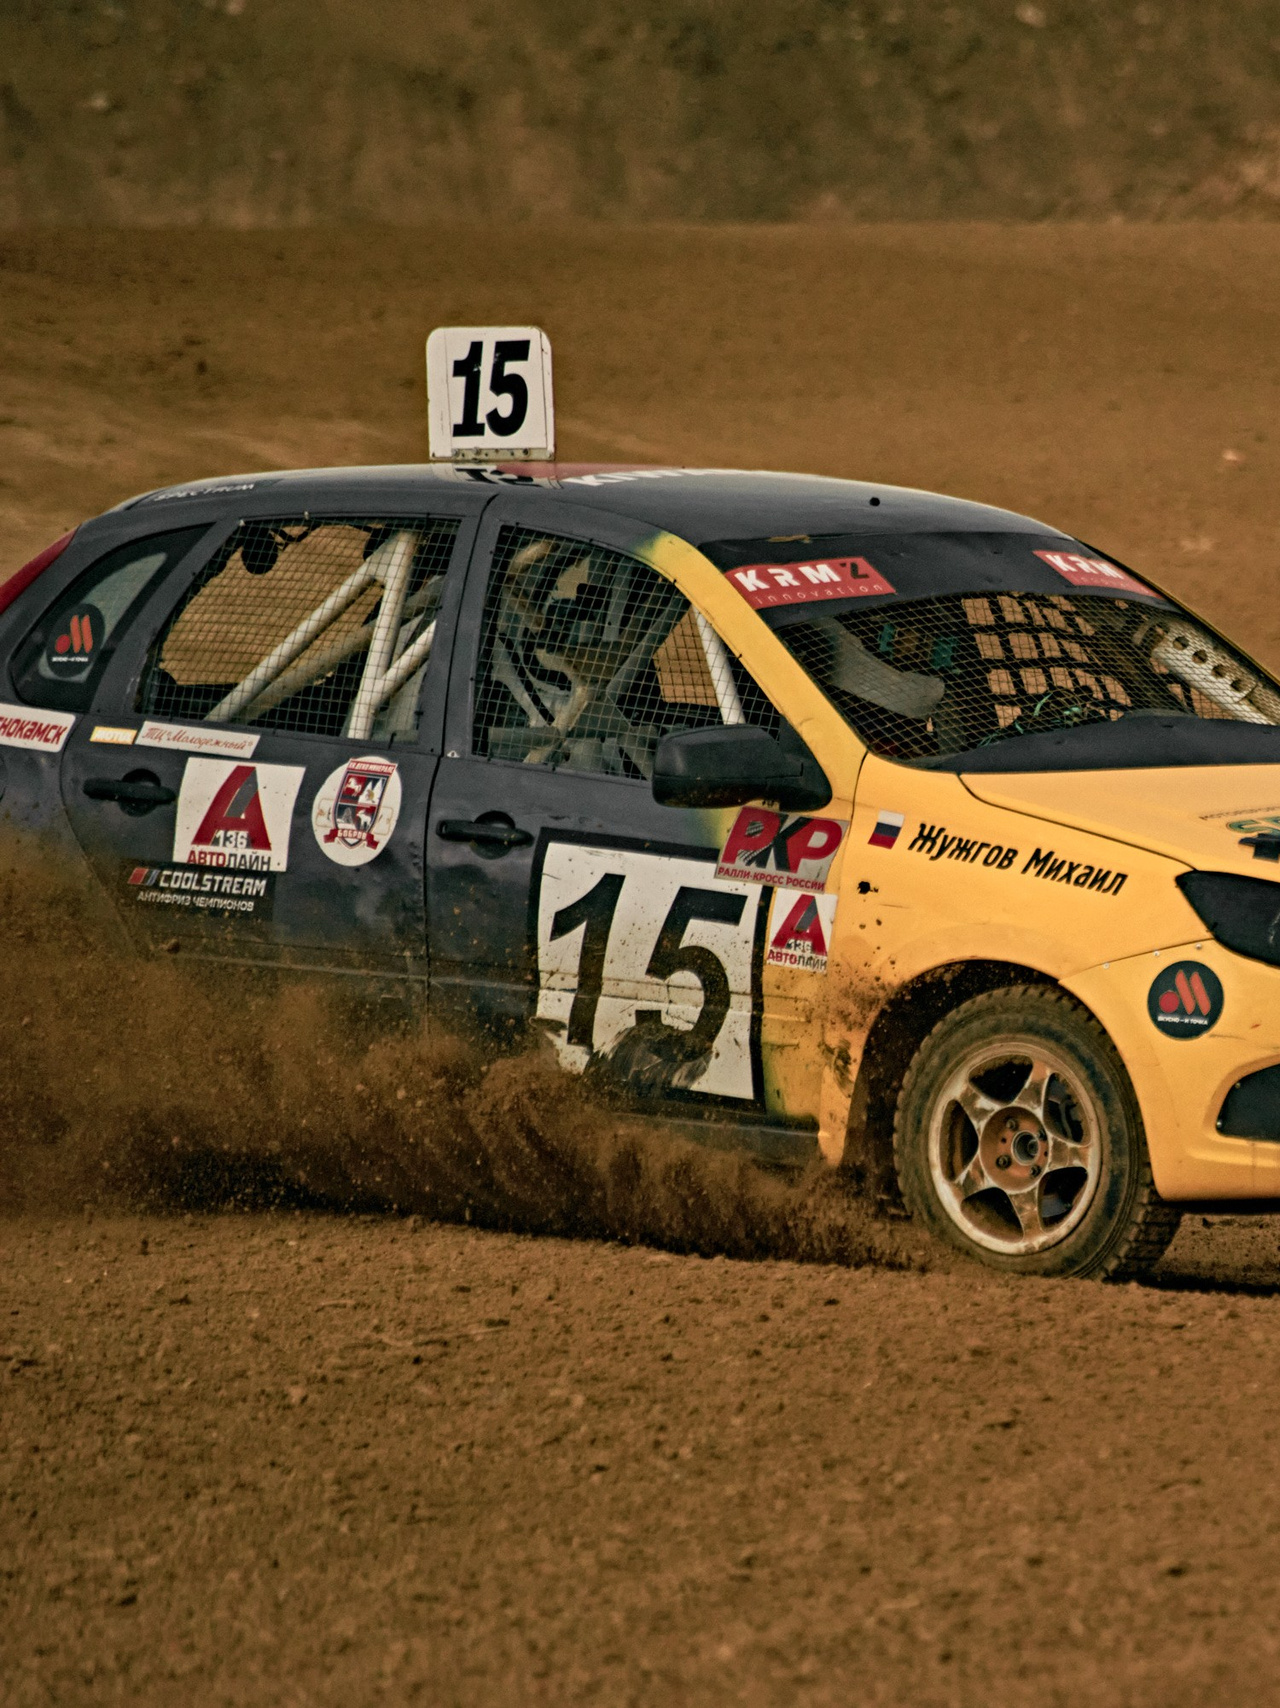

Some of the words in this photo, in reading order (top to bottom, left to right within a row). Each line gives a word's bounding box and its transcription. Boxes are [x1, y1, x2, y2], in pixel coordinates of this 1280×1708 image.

[452, 339, 531, 437] 15
[754, 583, 883, 604] innovation
[215, 830, 247, 847] 136
[187, 850, 271, 872] АВТОЛАЙН
[907, 823, 1018, 870] Жужгов
[1021, 847, 1128, 896] Михаил
[159, 871, 267, 896] COOLSTREAM
[717, 866, 784, 885] РАЛЛИ-КРОСС
[786, 876, 825, 891] РОССИИ
[137, 891, 191, 906] АНТИФРИЗ
[192, 896, 254, 912] ЧЕМПИОНОВ
[549, 873, 748, 1063] 15
